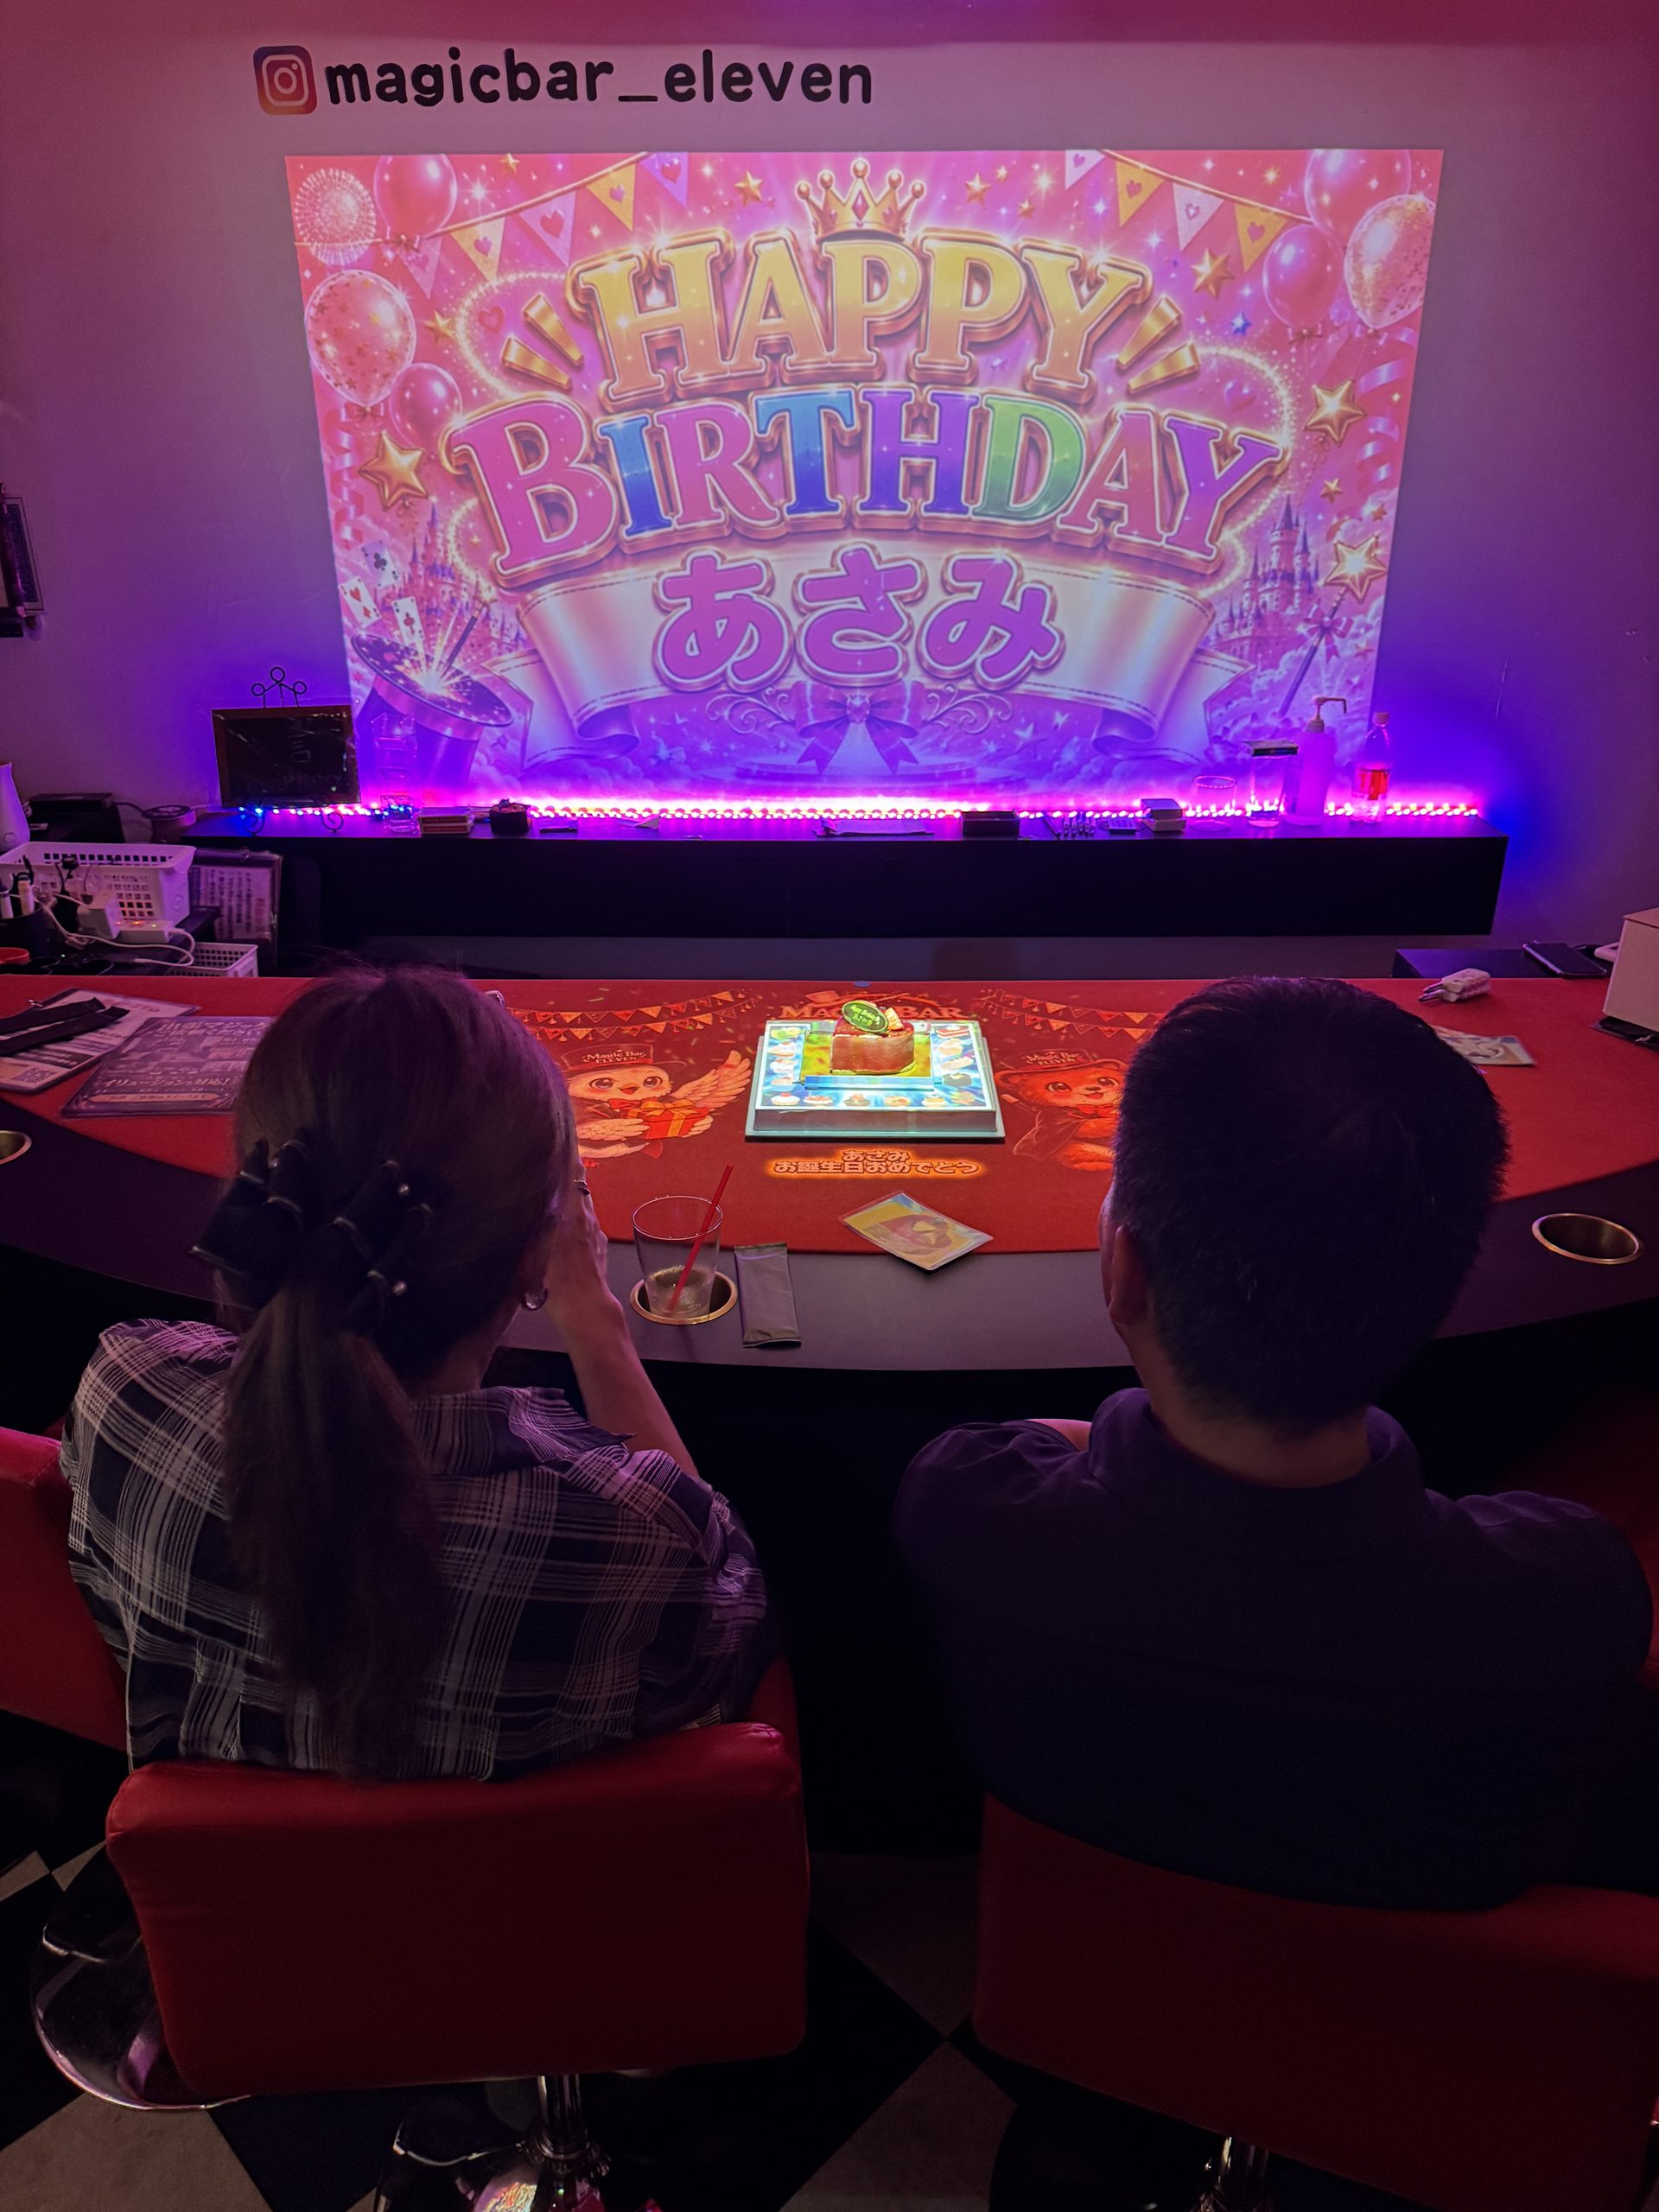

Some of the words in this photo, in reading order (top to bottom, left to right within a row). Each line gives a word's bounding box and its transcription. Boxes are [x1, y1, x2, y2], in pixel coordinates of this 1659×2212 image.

[325, 47, 873, 106] magicbar_eleven
[567, 227, 1150, 410] HAPPY
[444, 385, 1291, 584] BIRTHDAY
[653, 545, 1064, 689] あさみ
[898, 1006, 970, 1019] BAR
[587, 1050, 623, 1060] Magic
[773, 1160, 980, 1174] お誕生日おめでとう
[842, 1150, 911, 1162] あさみ
